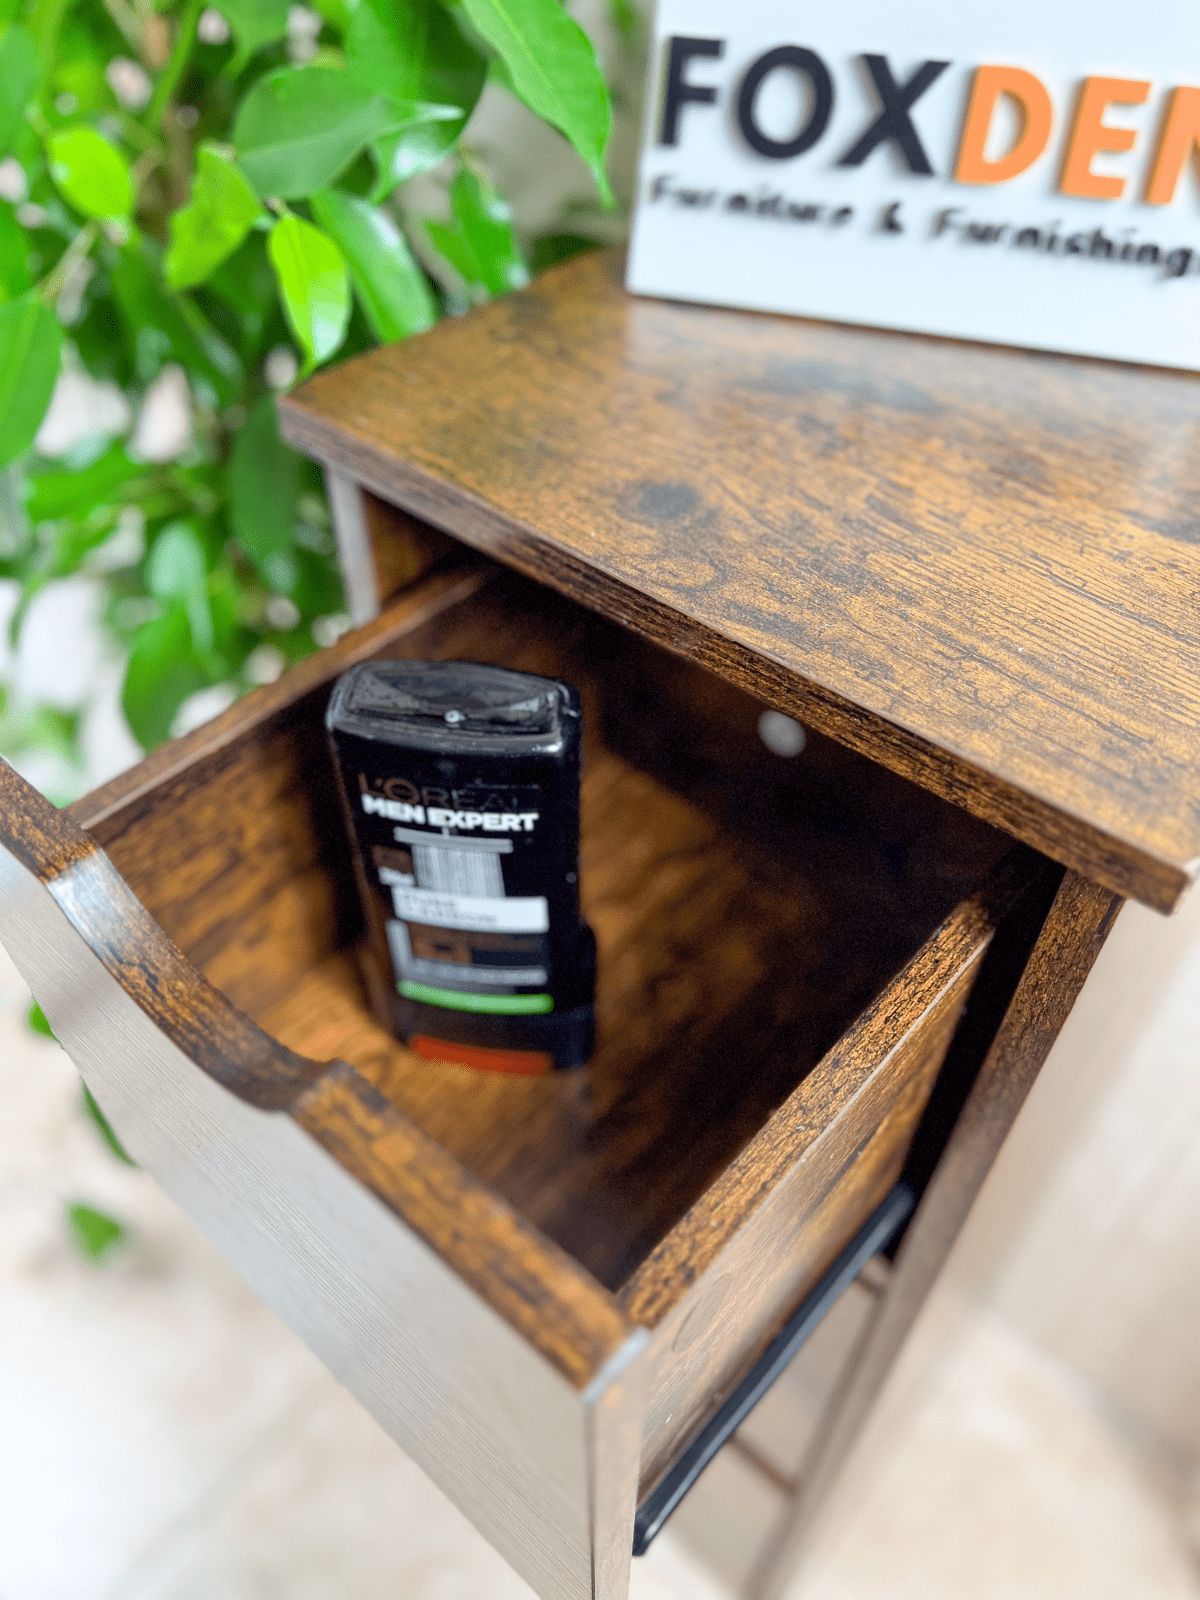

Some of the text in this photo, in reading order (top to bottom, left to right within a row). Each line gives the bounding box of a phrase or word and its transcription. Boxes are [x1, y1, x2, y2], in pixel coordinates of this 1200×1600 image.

[649, 174, 1200, 281] Furniture & Furnishing
[361, 793, 540, 831] MEN EXPERT
